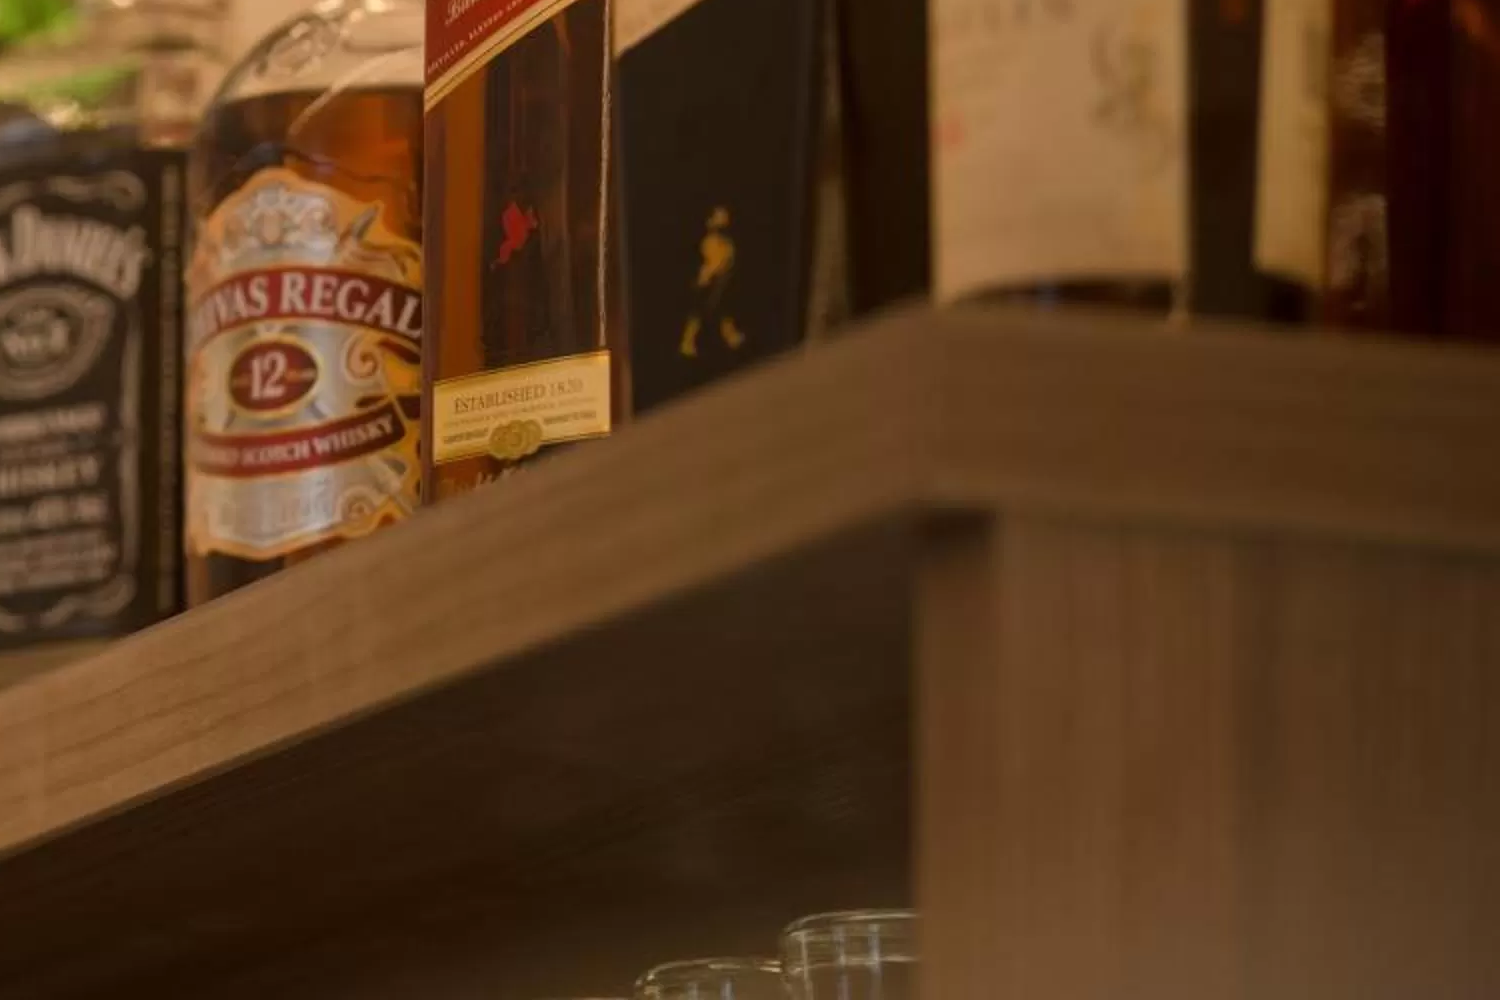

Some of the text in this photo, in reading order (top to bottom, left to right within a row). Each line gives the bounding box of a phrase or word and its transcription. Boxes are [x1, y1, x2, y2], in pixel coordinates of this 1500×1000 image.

[279, 271, 423, 338] REGAL
[250, 350, 288, 400] 12
[454, 382, 547, 415] ESTABLISHED
[311, 412, 394, 457] WHISKY
